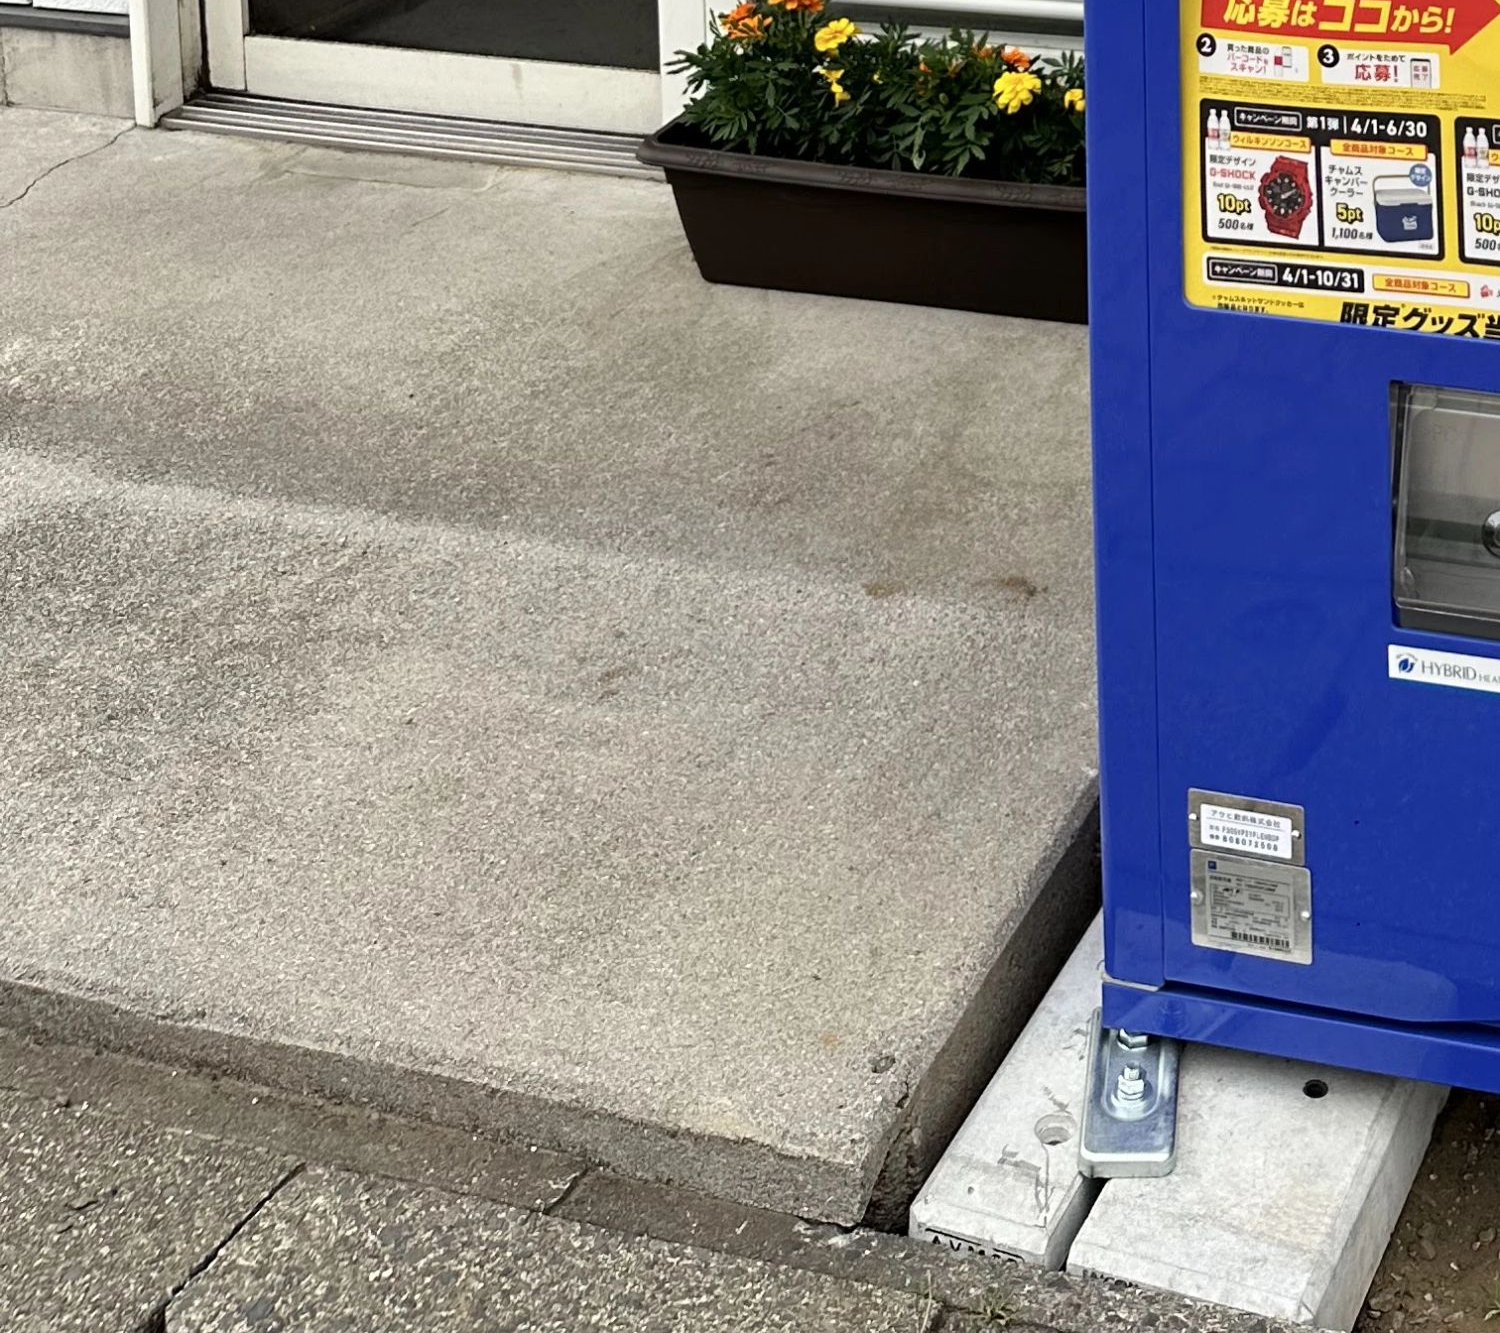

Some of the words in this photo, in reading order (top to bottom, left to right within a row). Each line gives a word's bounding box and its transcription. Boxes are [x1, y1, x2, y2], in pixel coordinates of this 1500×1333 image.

[1347, 53, 1406, 63] ポイントをためて
[1355, 65, 1398, 82] 応募!
[1307, 117, 1339, 130] 第1弾
[1351, 119, 1427, 137] 4/1-6/30
[1218, 194, 1251, 213] 10pt
[1336, 203, 1363, 223] 5pt
[1283, 268, 1359, 286] 4/1-10/31
[1422, 661, 1476, 680] HYBRID
